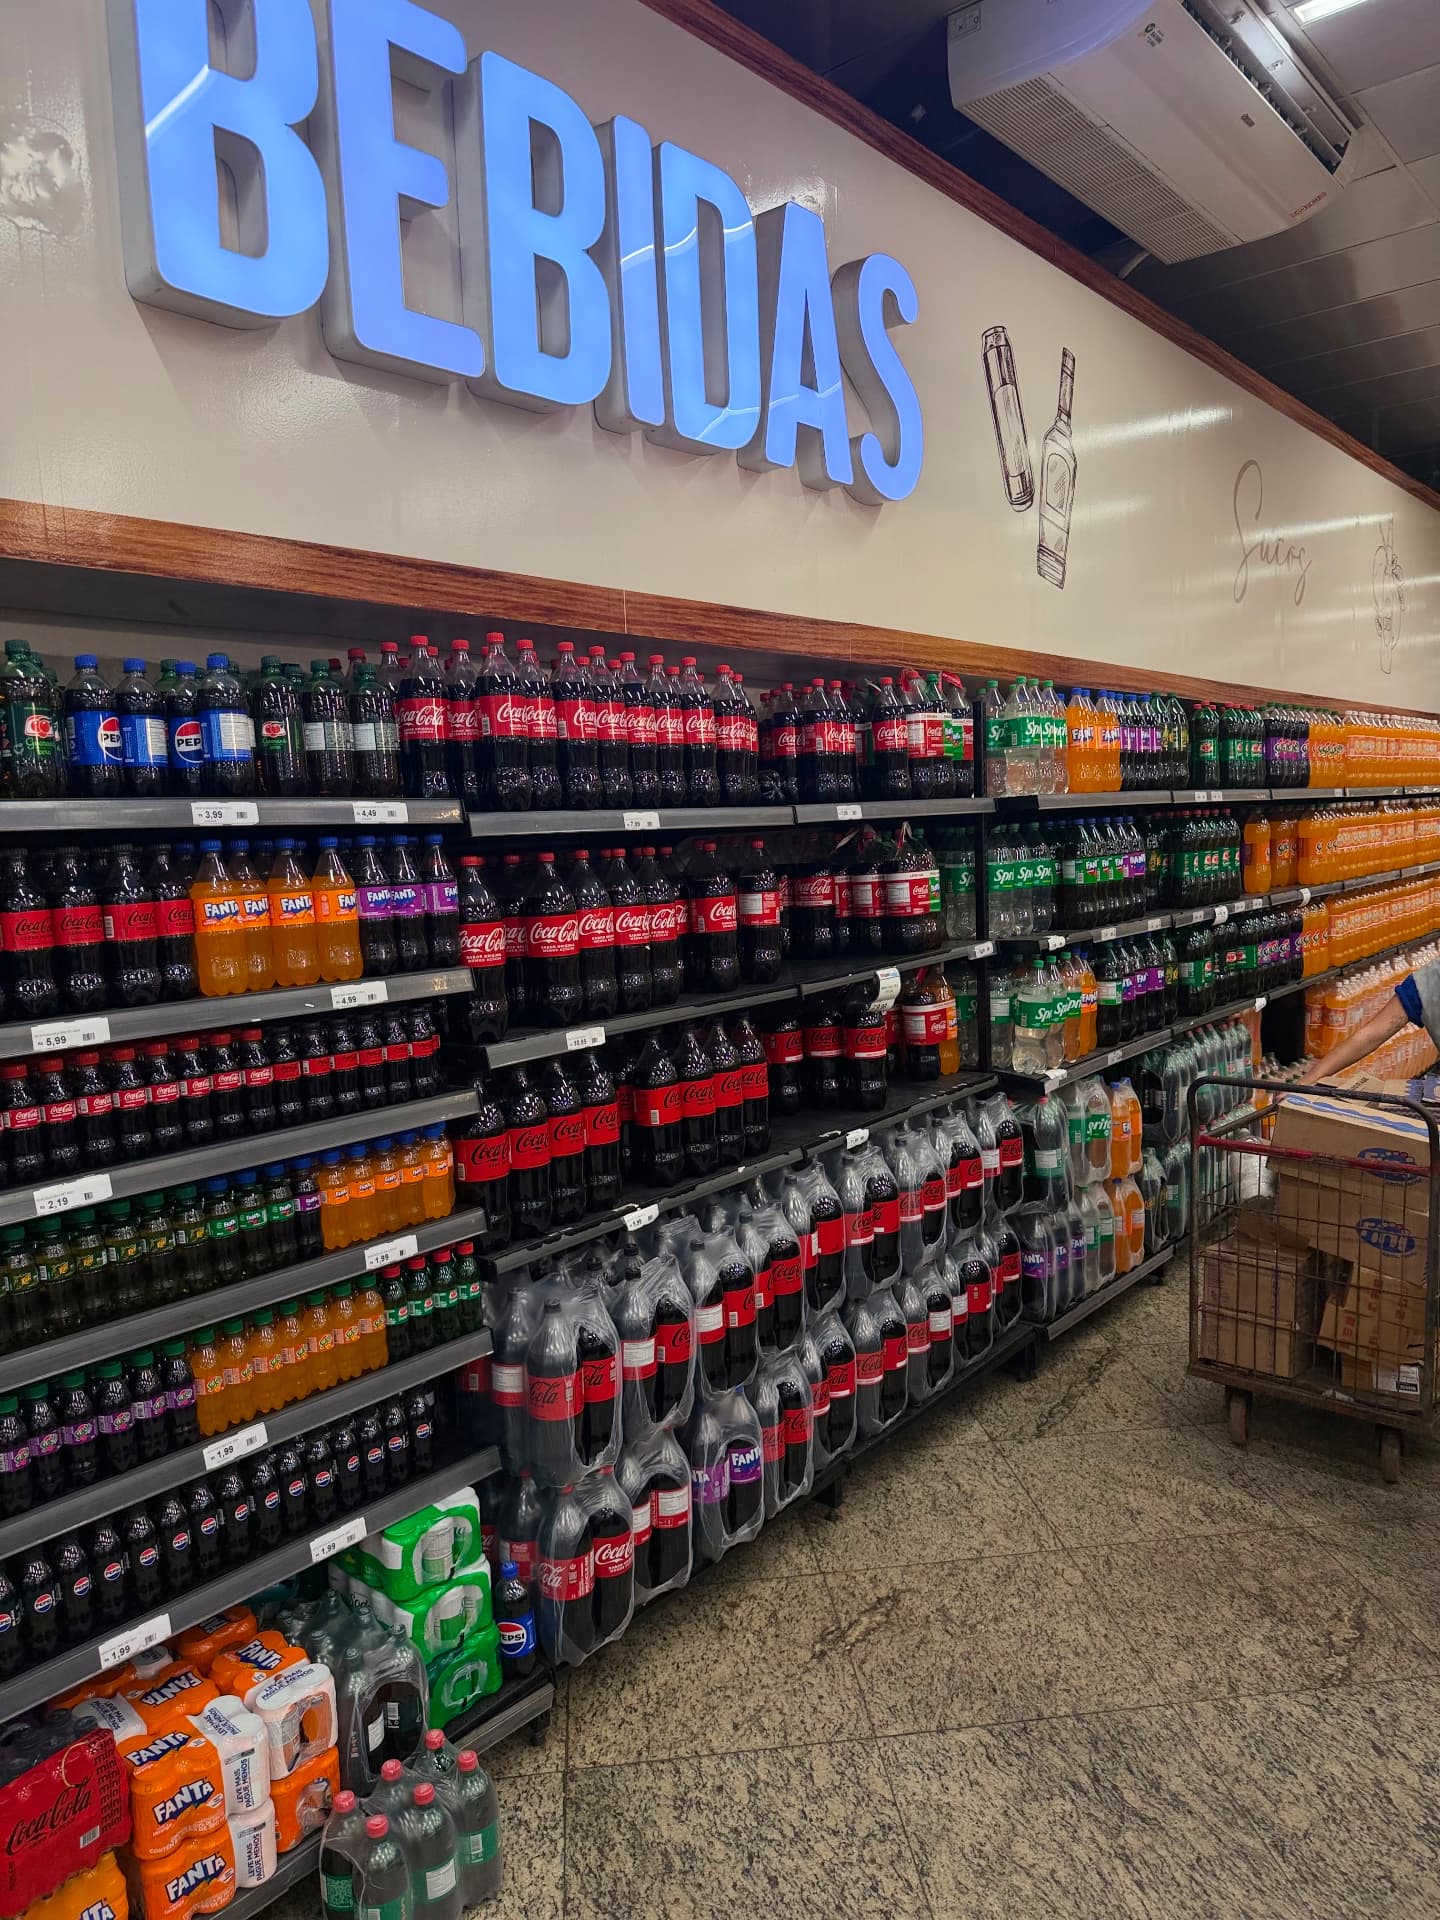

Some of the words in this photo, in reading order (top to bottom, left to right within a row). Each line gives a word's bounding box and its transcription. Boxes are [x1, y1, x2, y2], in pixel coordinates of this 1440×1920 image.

[130, 0, 924, 503] BEBIDAS
[103, 733, 120, 743] PEP
[177, 739, 200, 748] PEP
[205, 810, 223, 820] 3,99
[362, 810, 377, 818] 4,49
[204, 901, 238, 918] FANTA
[244, 896, 268, 912] FAN
[338, 893, 356, 908] FAN
[46, 1035, 66, 1046] 5,99
[516, 1128, 549, 1152] Coca-C
[48, 1196, 68, 1210] 2,19
[217, 1445, 234, 1459] 1,99
[732, 1447, 760, 1466] FANT
[321, 1542, 336, 1554] 1,99
[595, 1543, 633, 1566] Coca-C
[112, 1644, 130, 1660] 1,99
[240, 1639, 282, 1669] FANTA
[142, 1671, 202, 1706] FANTA
[126, 1731, 190, 1766] FANTA
[234, 1768, 242, 1786] MAIS
[239, 1758, 248, 1785] MENOS
[153, 1779, 214, 1823] FANTA
[242, 1784, 252, 1808] PAGUE
[7, 1776, 92, 1856] Coca-Cola
[165, 1854, 226, 1900] FANTA
[248, 1859, 256, 1878] LEVE
